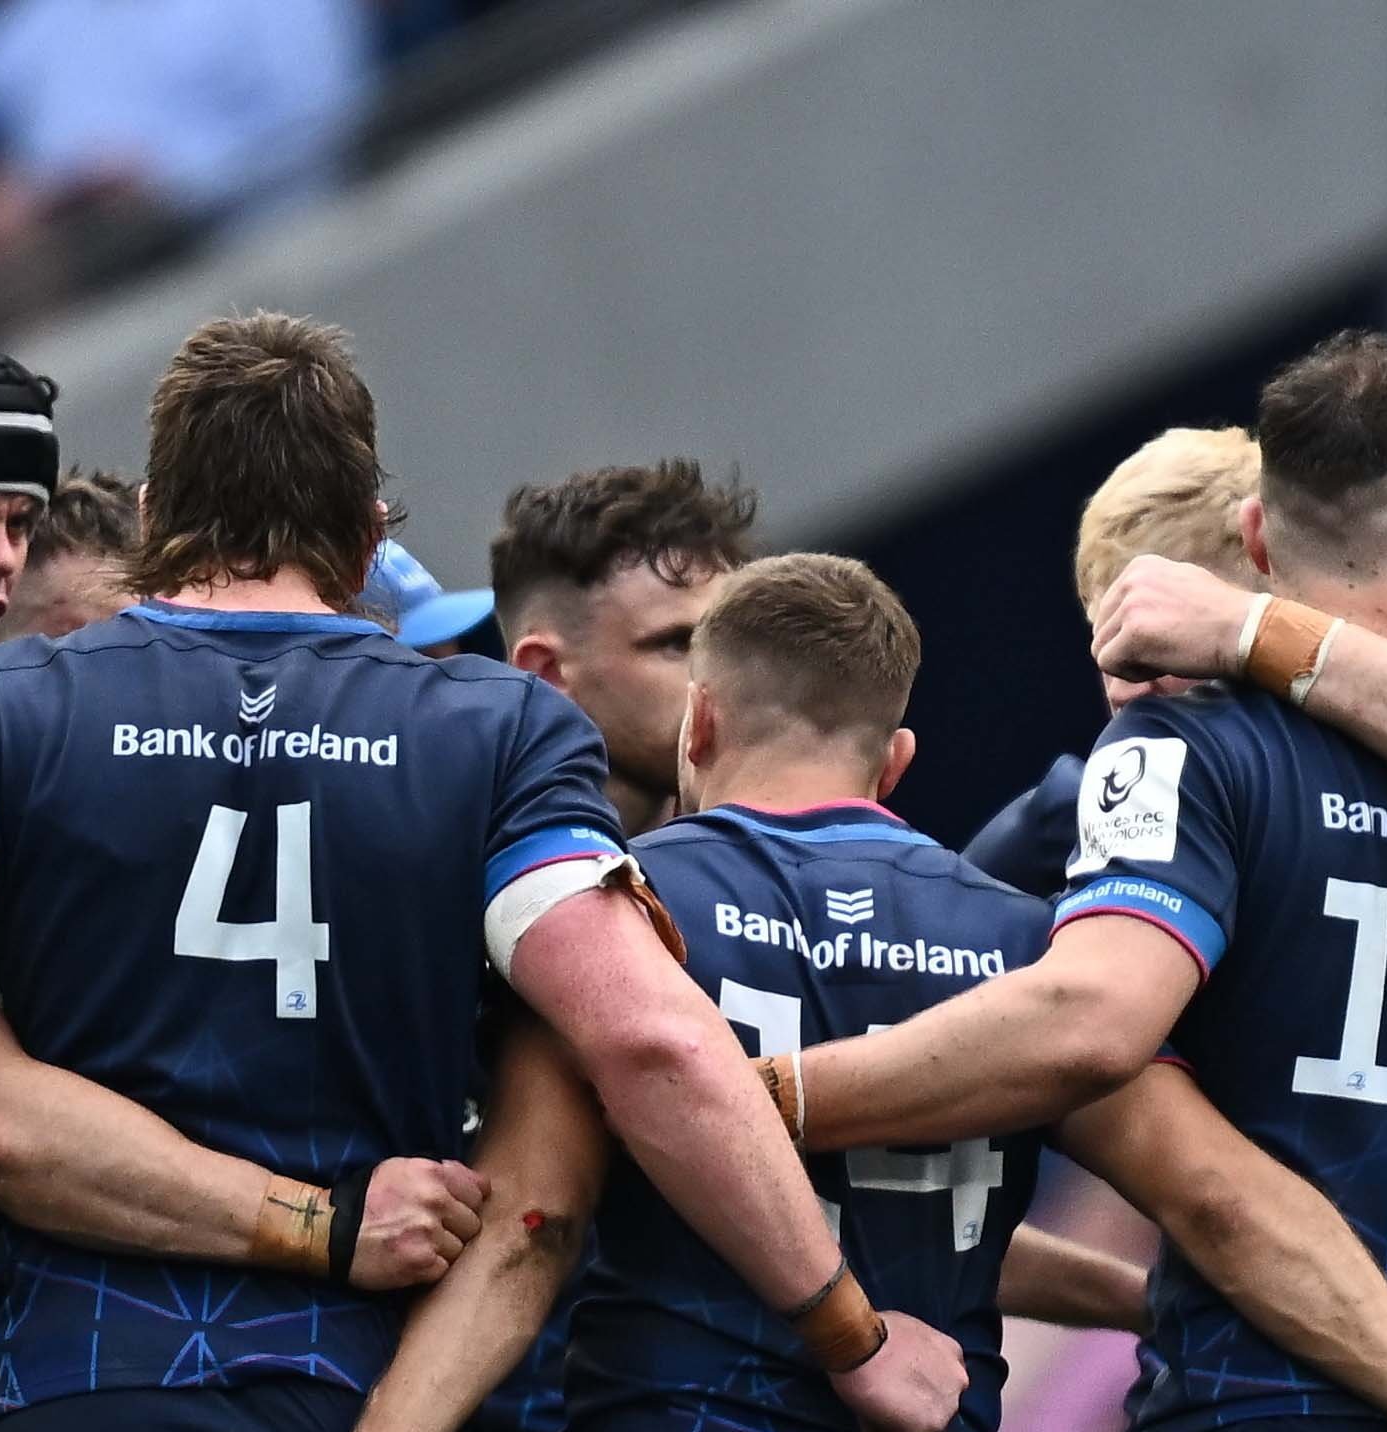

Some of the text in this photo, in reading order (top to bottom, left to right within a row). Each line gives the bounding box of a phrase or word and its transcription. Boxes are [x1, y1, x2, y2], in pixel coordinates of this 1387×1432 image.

[113, 724, 397, 767] Bank of Ireland
[174, 801, 330, 1018] 4
[1095, 882, 1114, 897] of
[1113, 881, 1183, 913] Ireland
[715, 902, 1005, 977] Bank of Ireland
